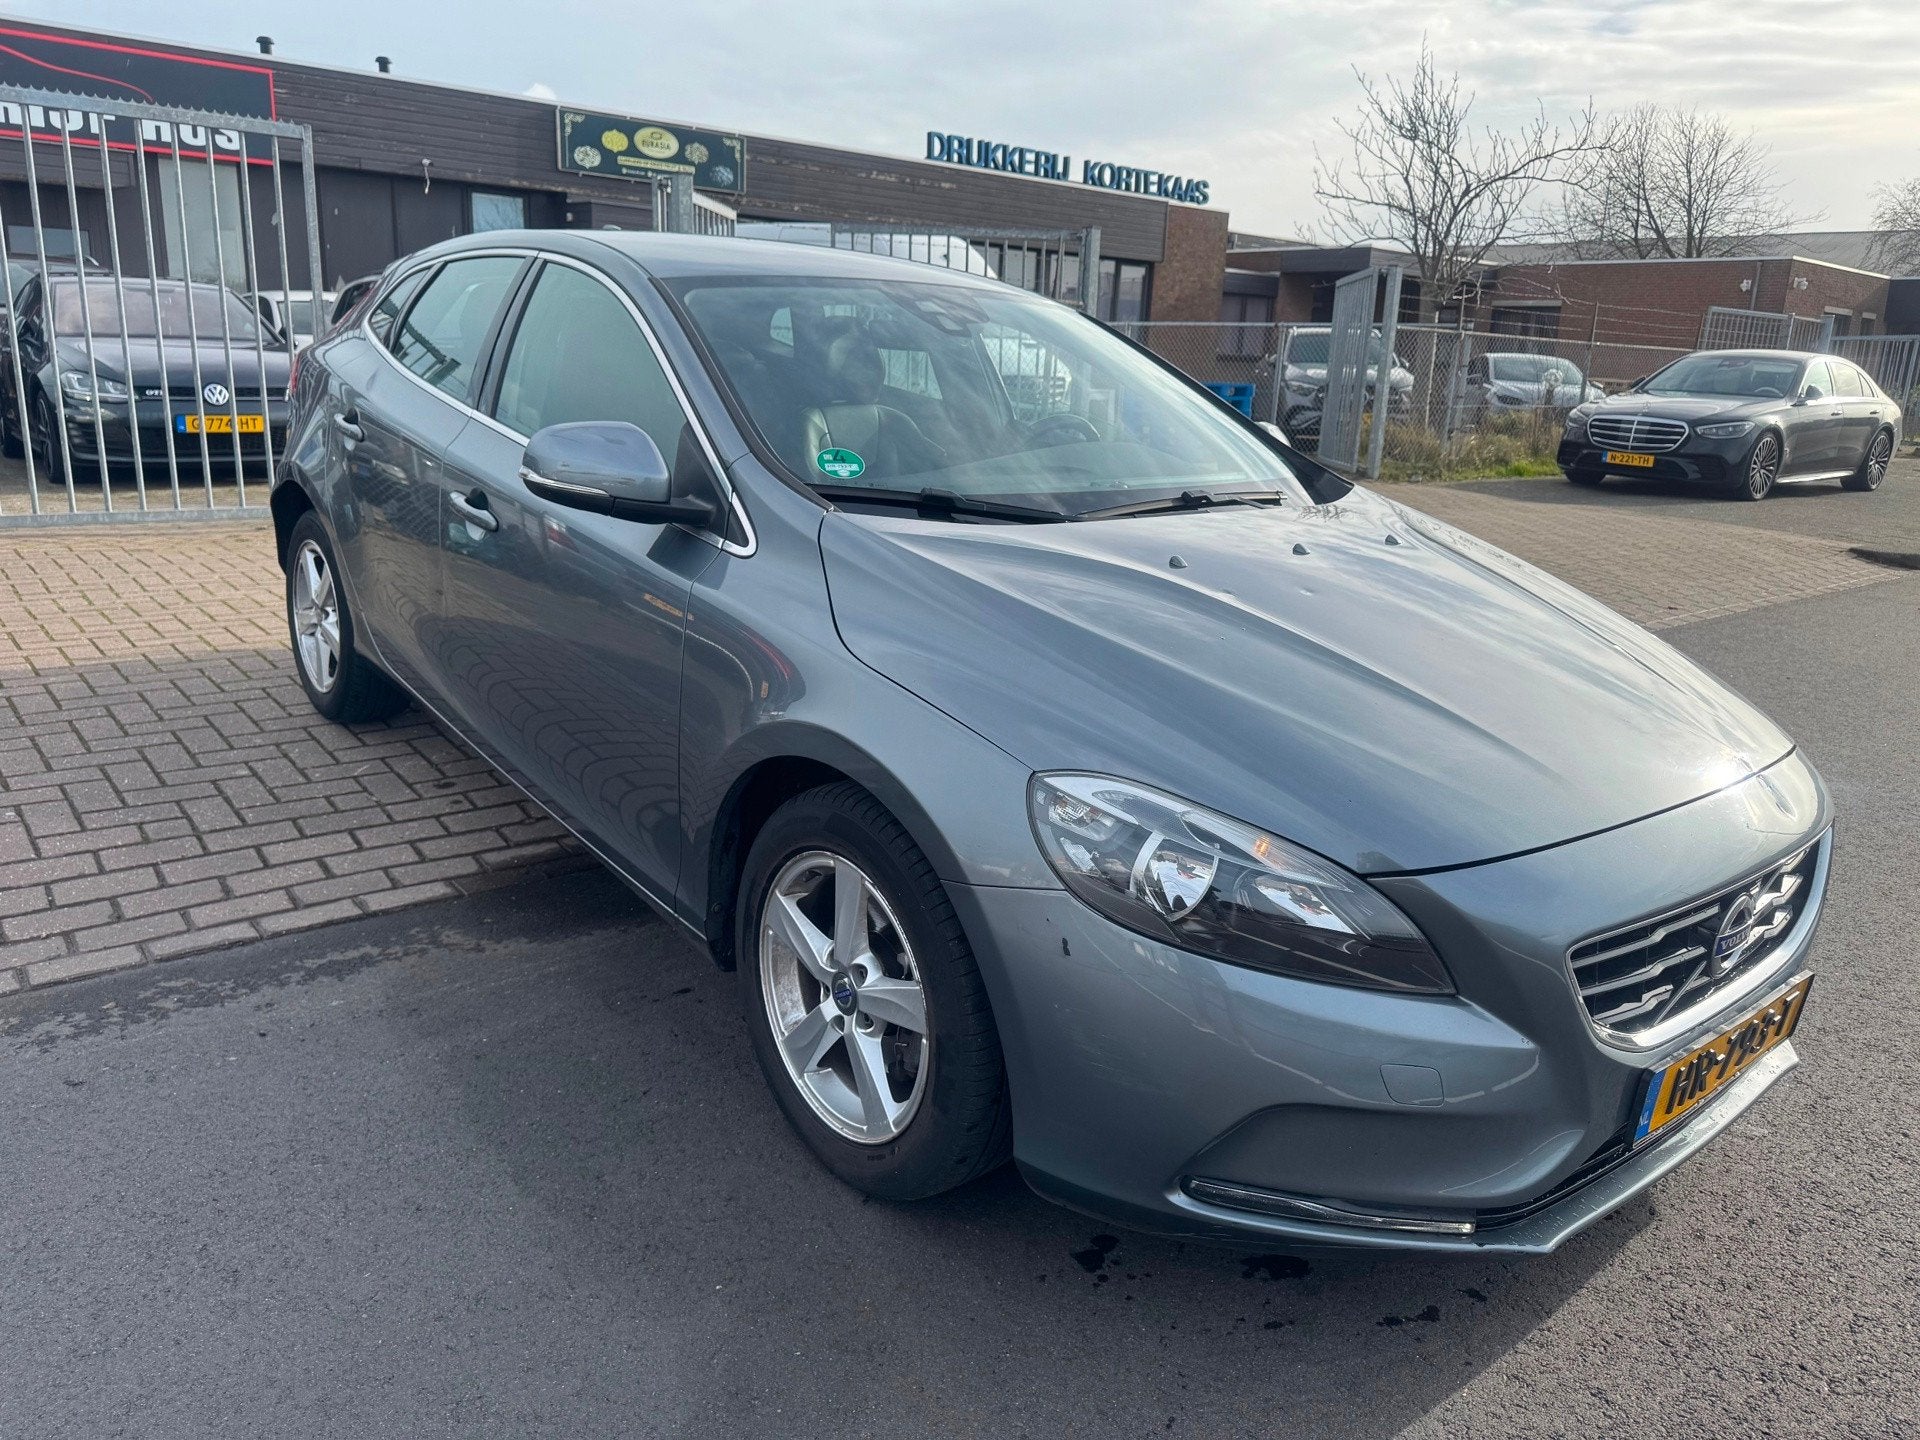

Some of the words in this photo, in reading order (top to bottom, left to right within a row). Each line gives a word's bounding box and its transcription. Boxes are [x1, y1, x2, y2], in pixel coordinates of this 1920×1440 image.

[926, 131, 1070, 181] DRUKKERIJ
[1083, 160, 1210, 204] KORTEKAAS
[1610, 454, 1650, 465] N-221-TH
